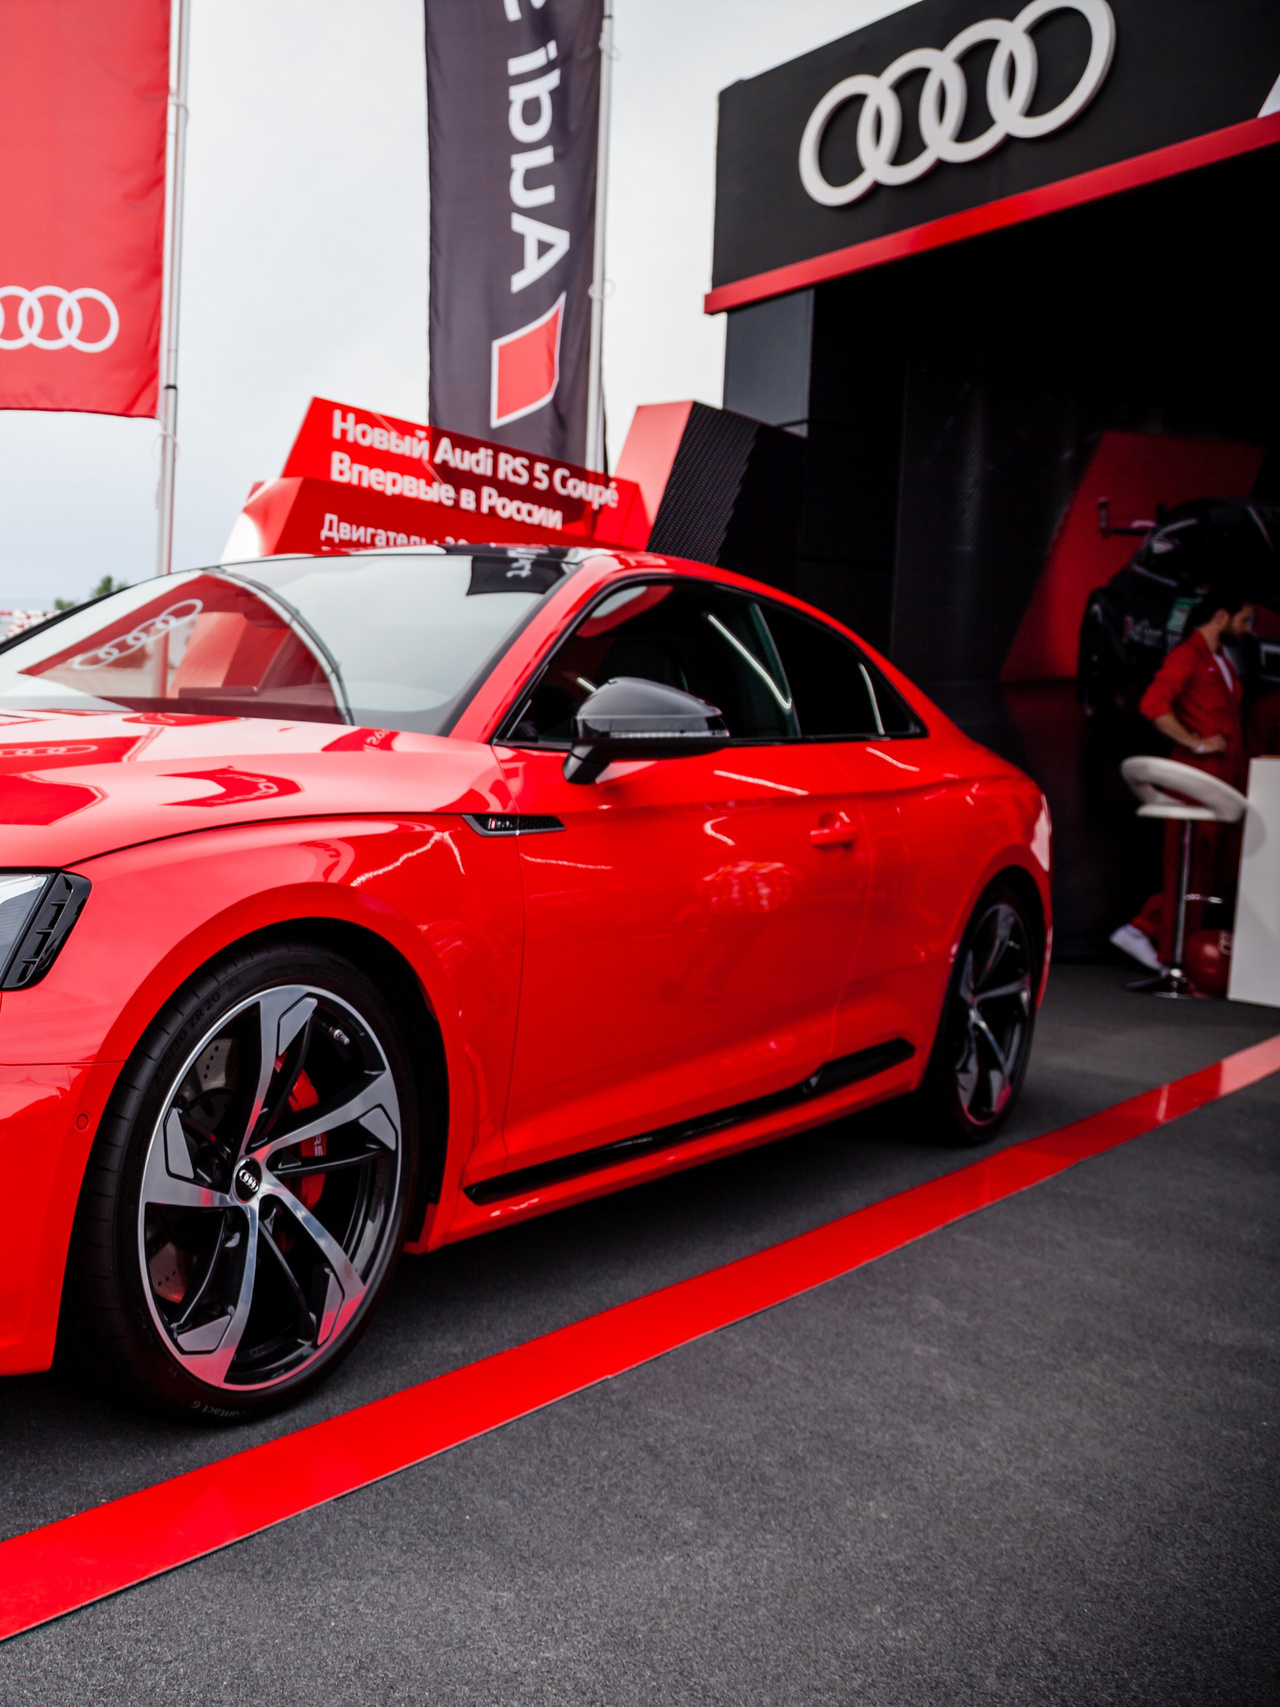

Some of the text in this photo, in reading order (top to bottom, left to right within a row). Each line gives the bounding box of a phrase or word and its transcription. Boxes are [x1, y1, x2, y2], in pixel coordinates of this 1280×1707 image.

[330, 450, 563, 530] Впервые в России
[332, 409, 619, 510] Новый Audi RS 5 Coupé
[205, 991, 221, 1011] 20
